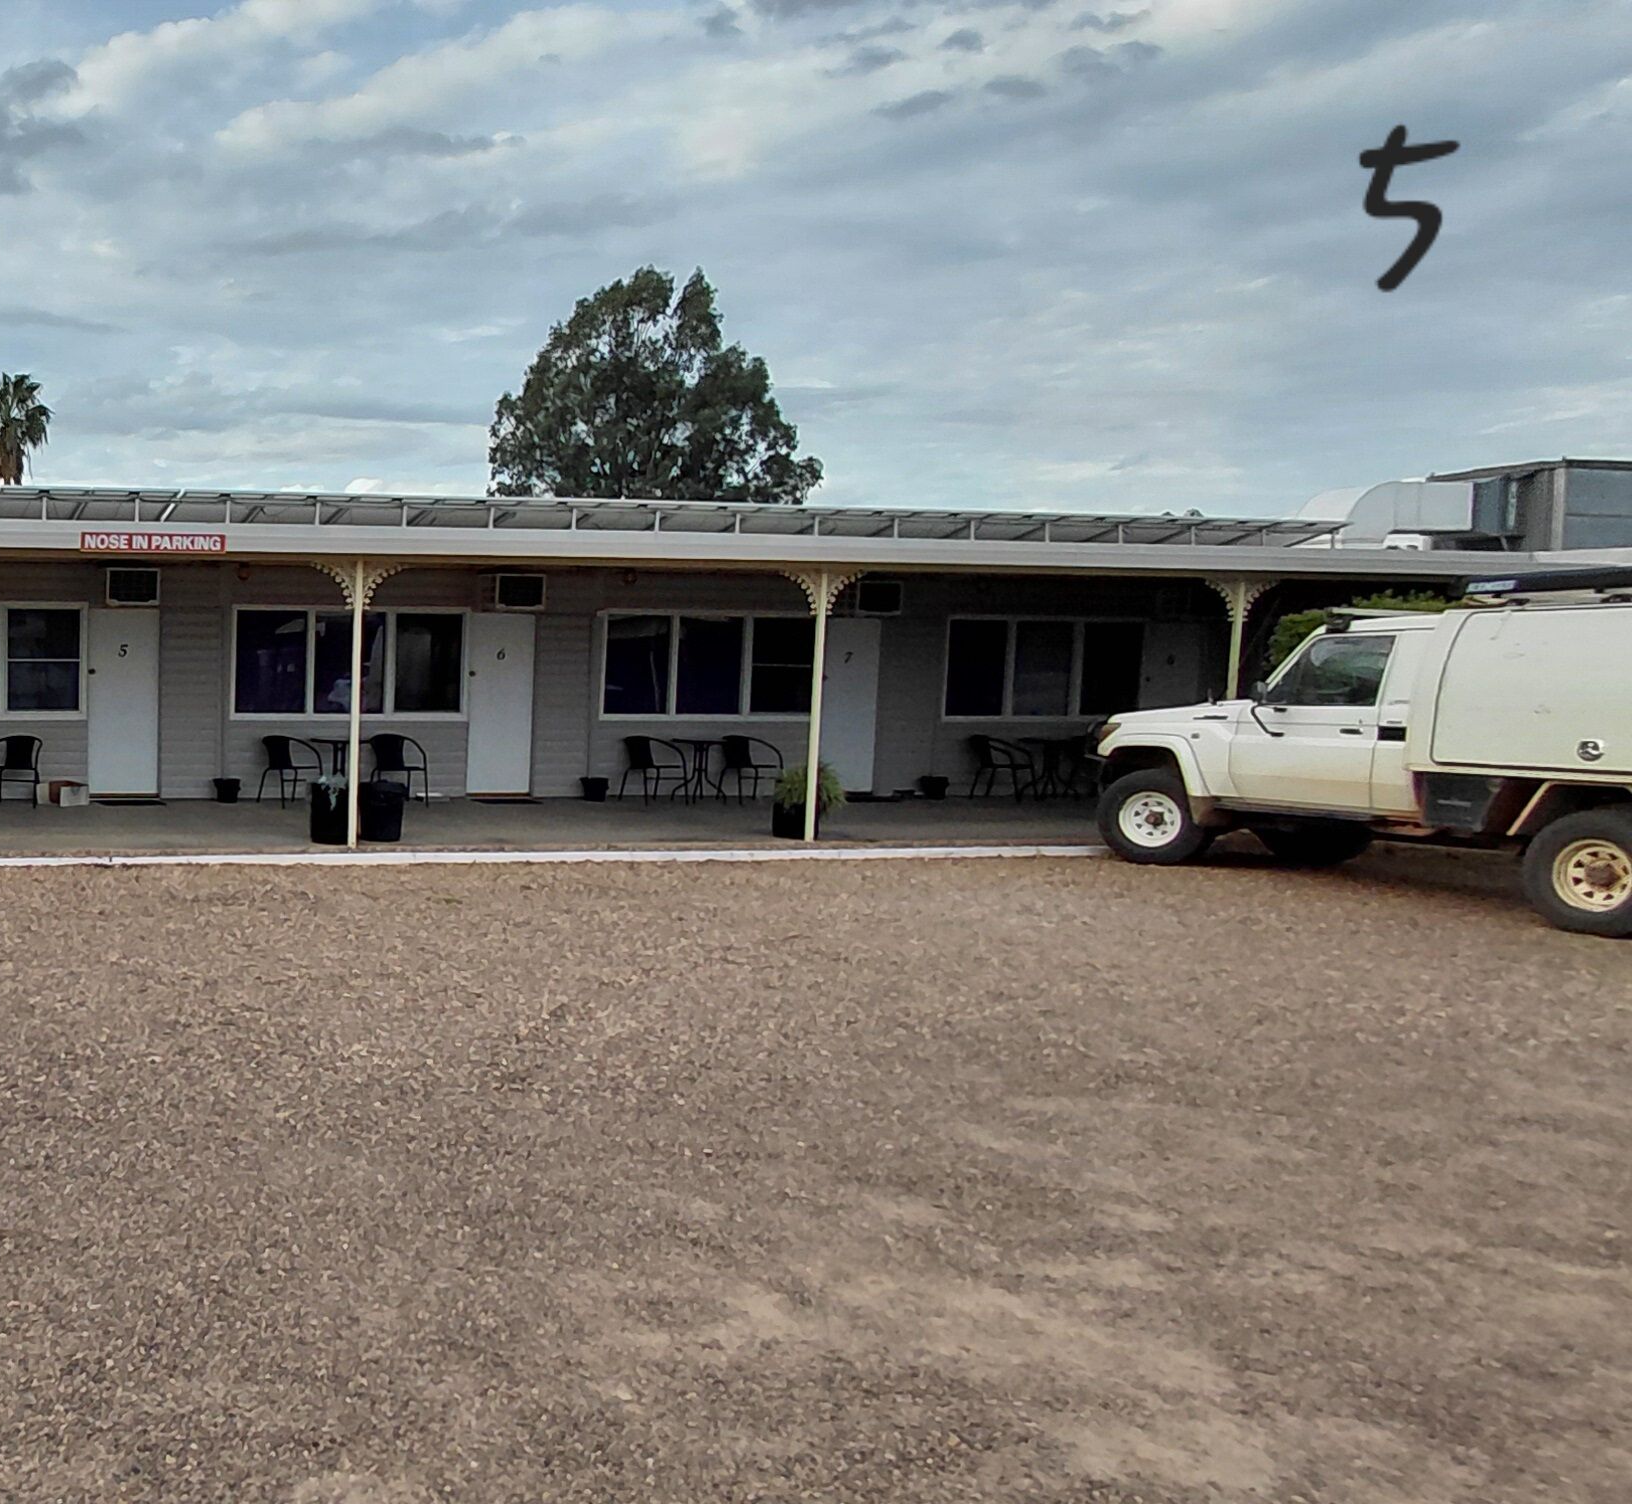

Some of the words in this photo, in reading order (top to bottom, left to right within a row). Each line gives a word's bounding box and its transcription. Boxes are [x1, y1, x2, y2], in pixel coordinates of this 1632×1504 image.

[84, 534, 128, 549] NOSE
[132, 535, 148, 549] IN
[151, 535, 221, 551] PARKING
[118, 644, 128, 657] 5
[496, 648, 506, 660] 6
[844, 651, 854, 664] 7
